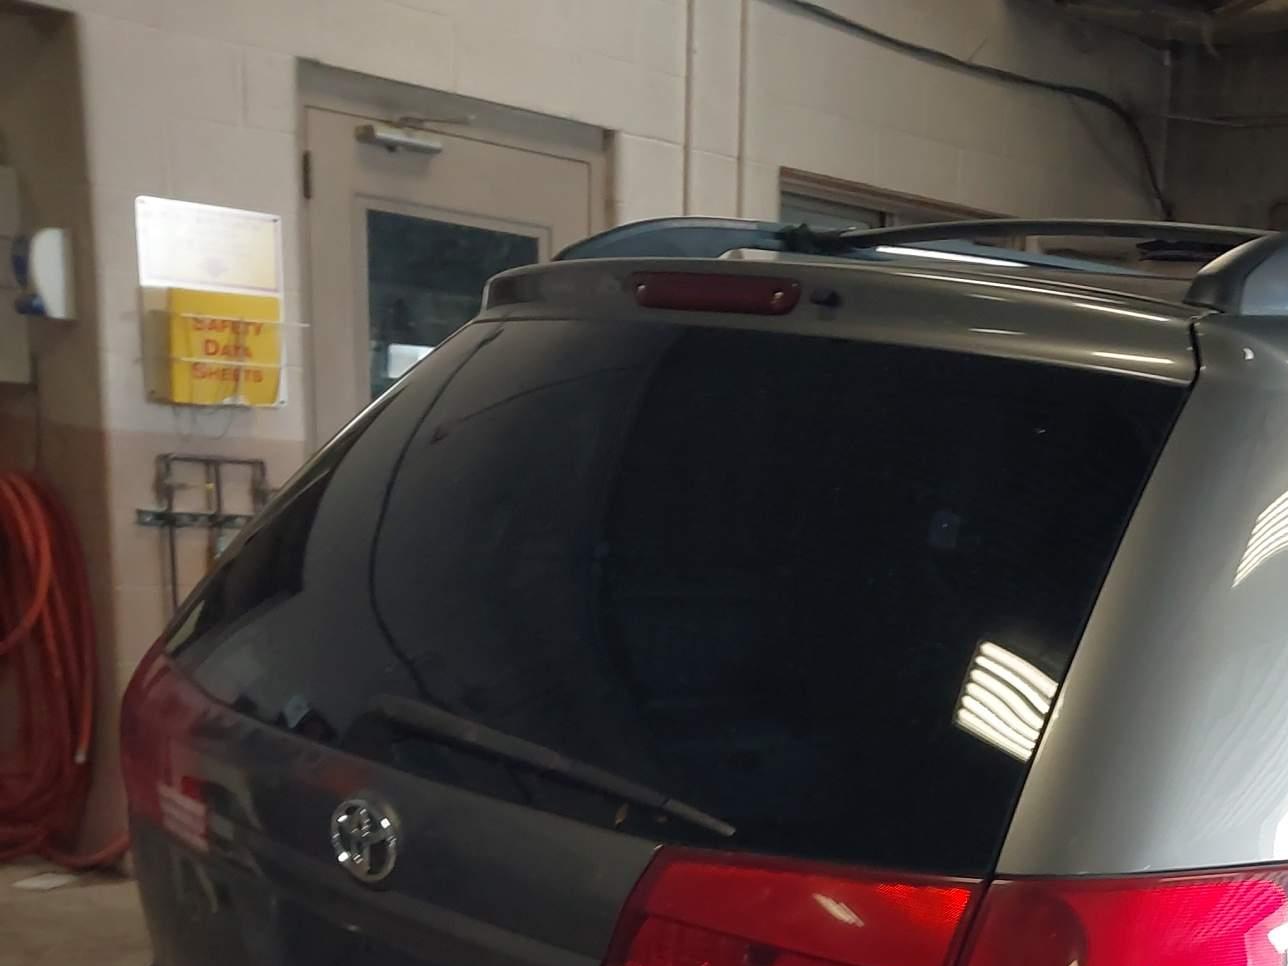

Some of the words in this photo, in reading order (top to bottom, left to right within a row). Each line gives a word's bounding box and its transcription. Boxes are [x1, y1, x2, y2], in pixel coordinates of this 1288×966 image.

[191, 317, 264, 336] SAFETY
[203, 338, 254, 359] DATA
[191, 362, 263, 384] SHEETS
